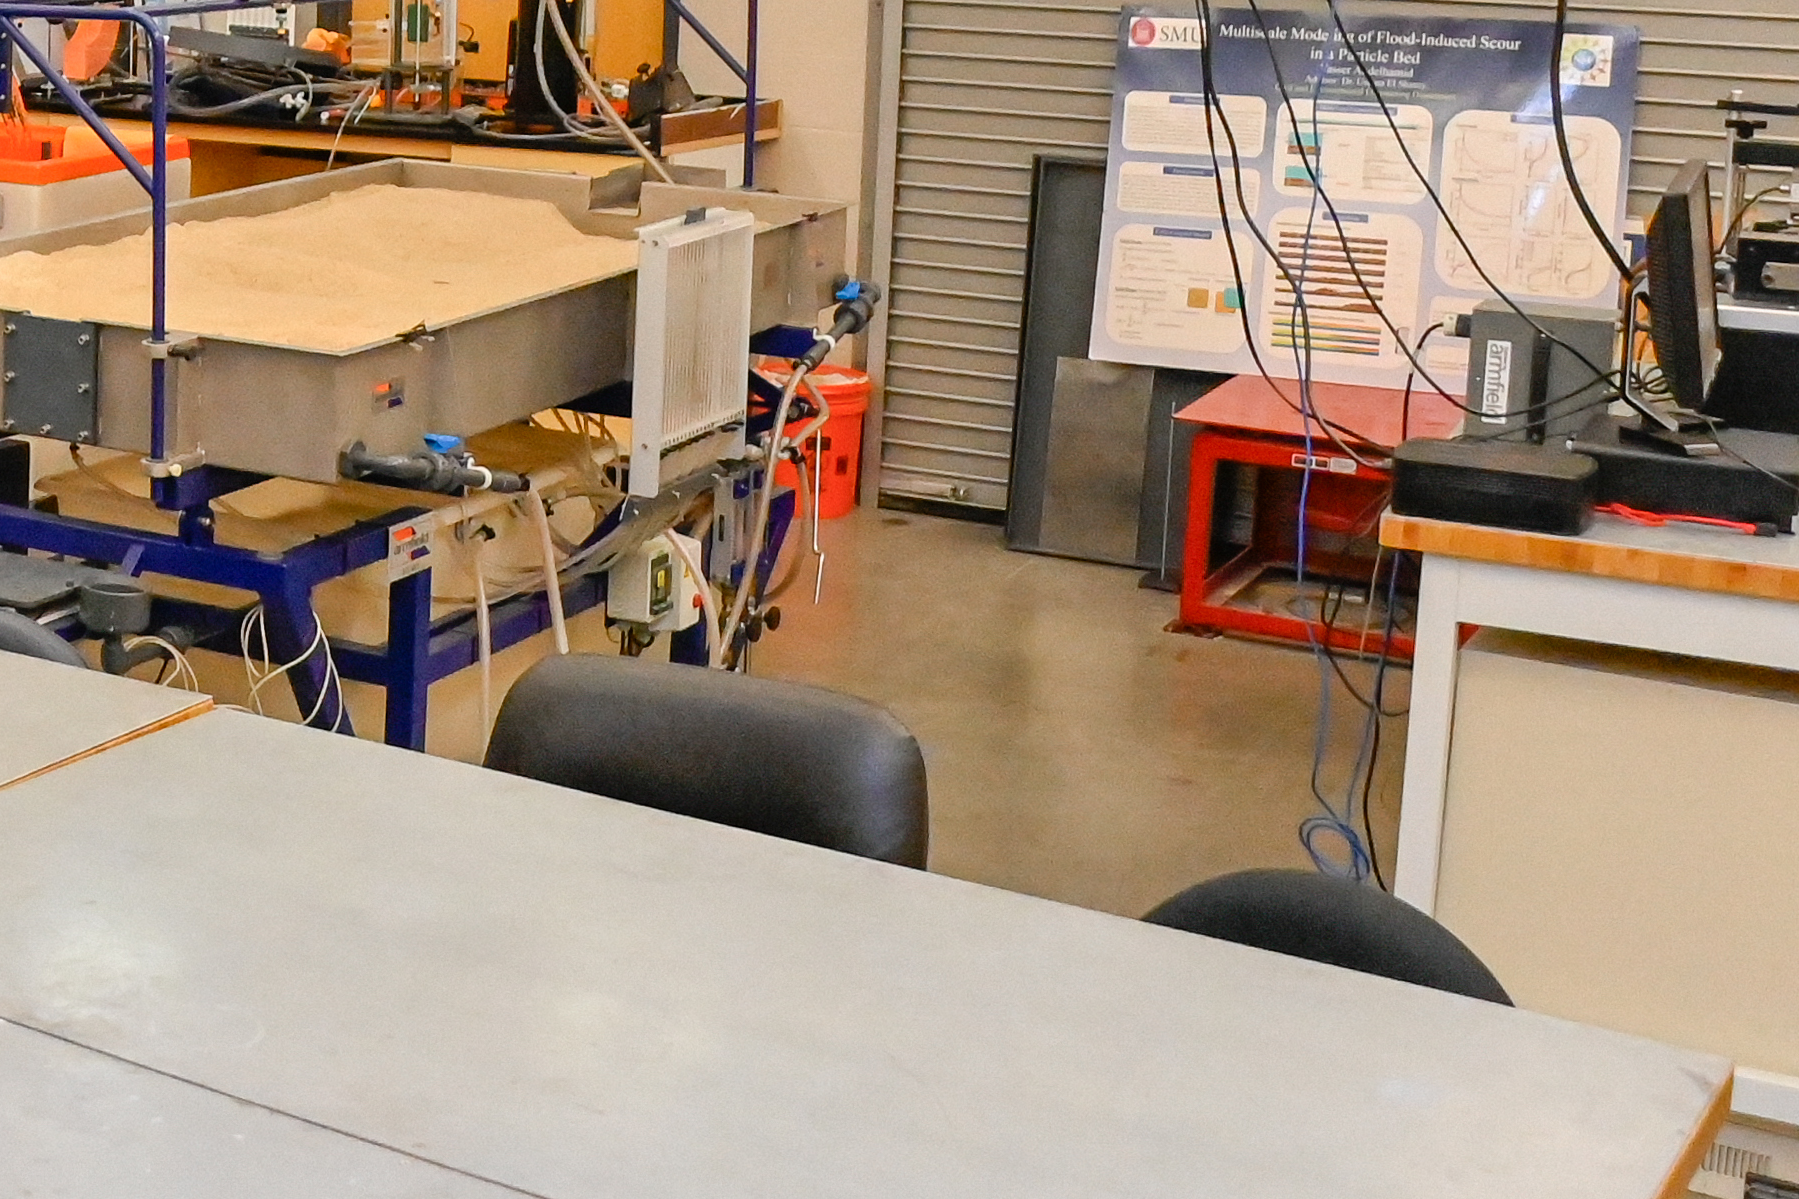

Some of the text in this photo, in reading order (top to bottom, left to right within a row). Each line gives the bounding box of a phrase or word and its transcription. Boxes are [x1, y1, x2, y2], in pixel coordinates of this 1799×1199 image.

[1358, 29, 1375, 43] of
[1376, 30, 1477, 49] Flood-Induced
[1479, 35, 1522, 51] Scour
[1310, 46, 1323, 60] in
[1338, 48, 1390, 63] Paticle
[1393, 50, 1421, 65] Bed
